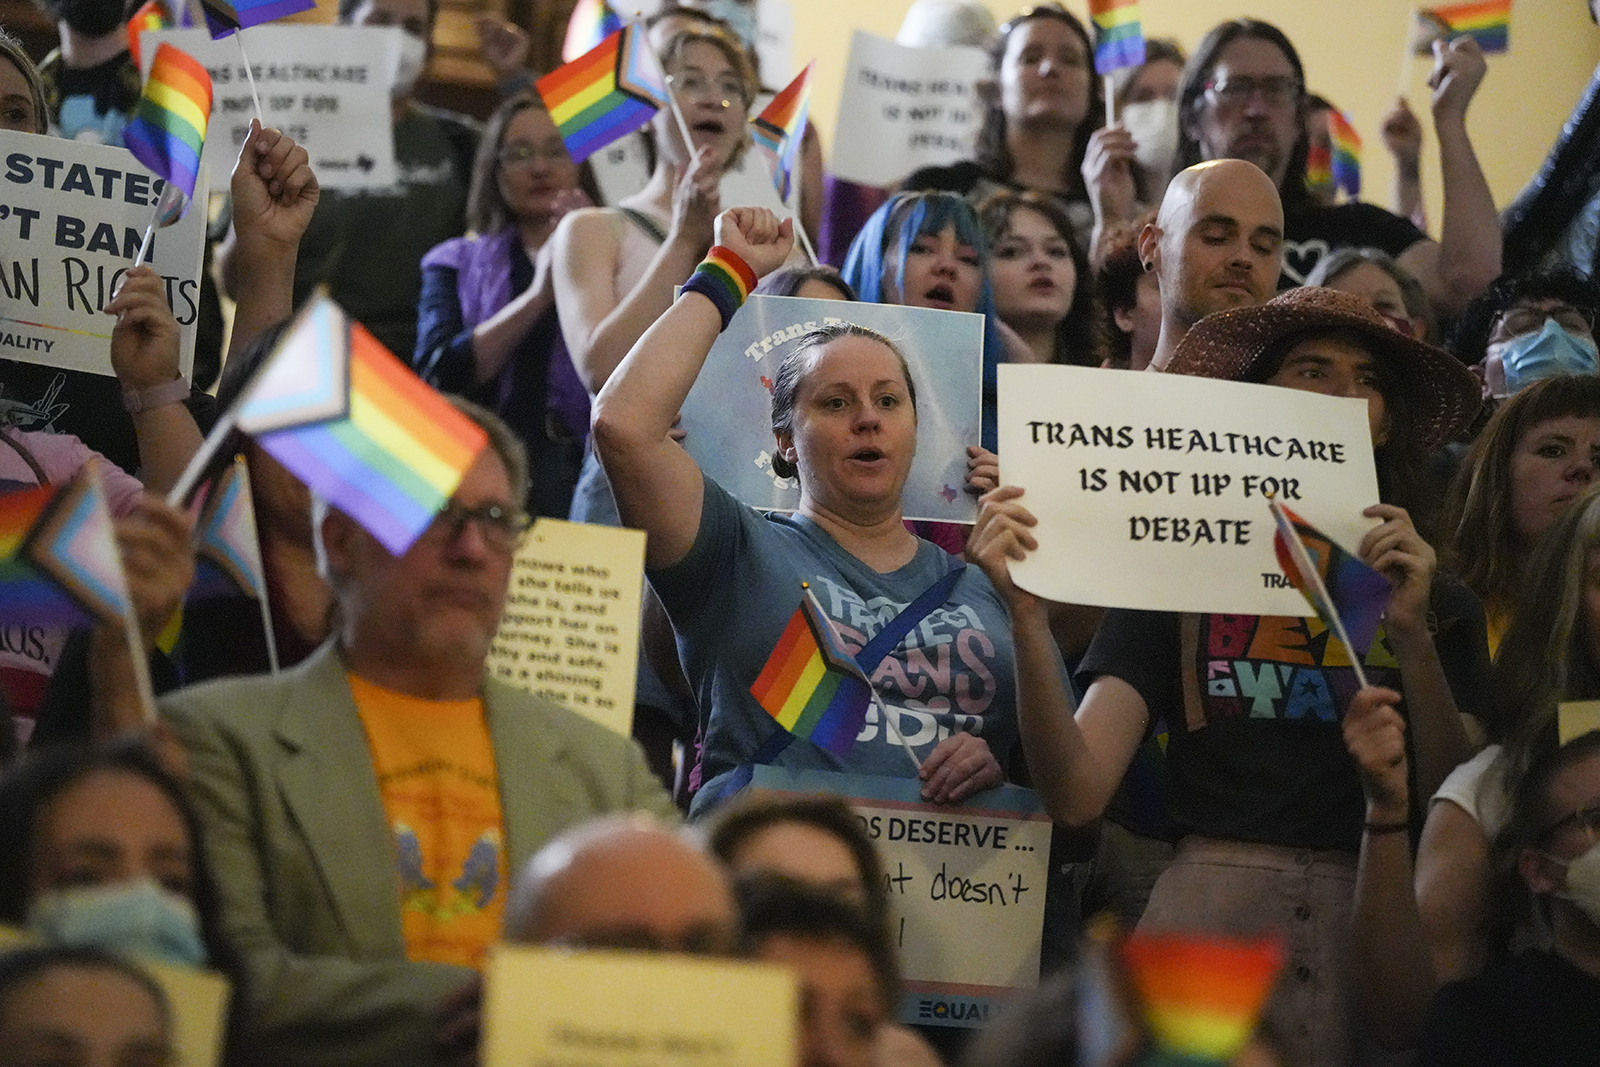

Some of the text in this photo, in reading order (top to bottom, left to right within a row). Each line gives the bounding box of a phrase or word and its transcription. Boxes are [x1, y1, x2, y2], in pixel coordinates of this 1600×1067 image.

[55, 214, 156, 264] BAN
[61, 257, 198, 326] RITS
[744, 320, 820, 363] Trans
[1026, 420, 1347, 464] TRANS HEALTHCARE
[1079, 467, 1303, 501] IS NOT UP FOR
[1128, 515, 1253, 547] DEBATE
[888, 817, 1009, 850] DESERVE
[930, 862, 1030, 906] doesn't
